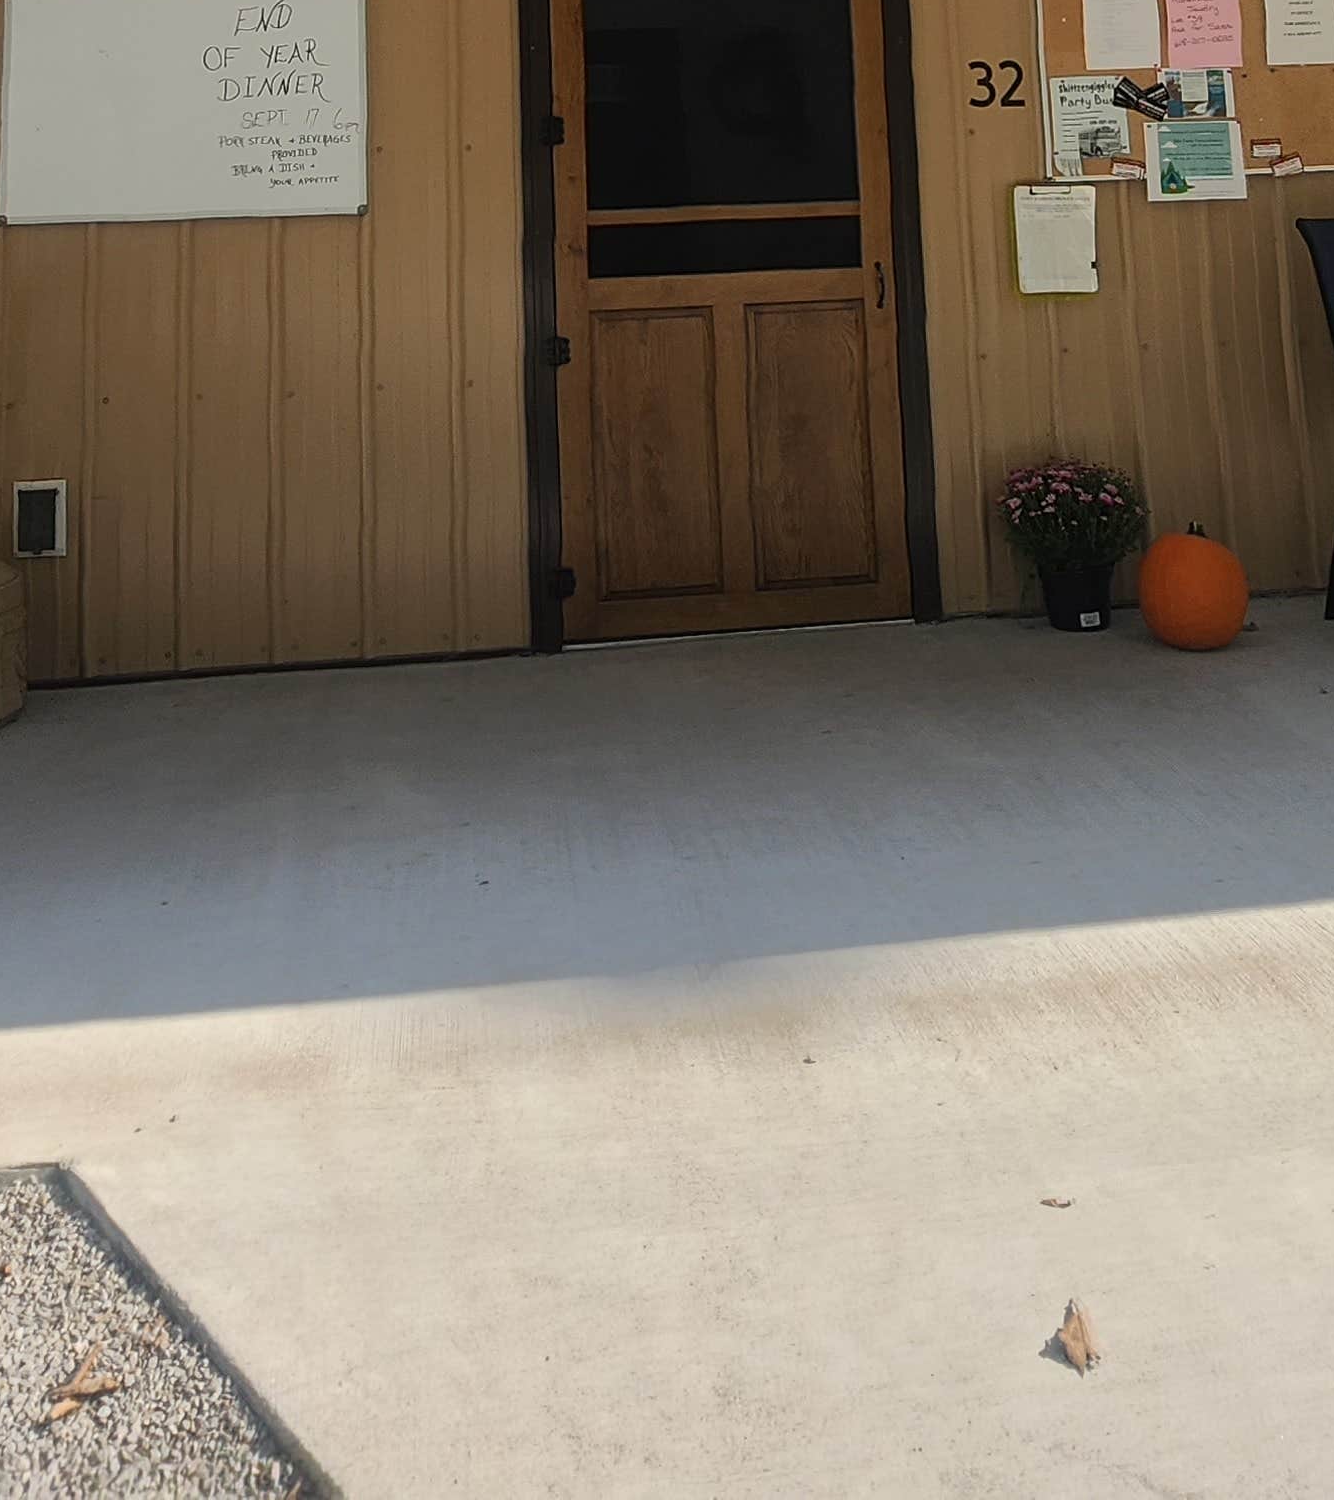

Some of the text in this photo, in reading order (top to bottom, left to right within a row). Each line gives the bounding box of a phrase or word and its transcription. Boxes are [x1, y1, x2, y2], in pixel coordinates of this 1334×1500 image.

[234, 0, 293, 36] END
[203, 38, 331, 71] OF YEAR
[217, 69, 332, 103] DINNER
[968, 60, 1025, 107] 32
[1060, 96, 1092, 109] Party
[242, 109, 290, 129] SEPT
[306, 108, 320, 126] 17
[218, 135, 244, 148] PORK
[248, 136, 282, 147] STEAK
[298, 134, 351, 147] BEVERAGES
[271, 147, 319, 161] PROVIDED
[231, 164, 264, 177] BRING
[268, 165, 274, 173] A
[279, 163, 305, 173] DISH
[299, 175, 340, 185] APPETITE
